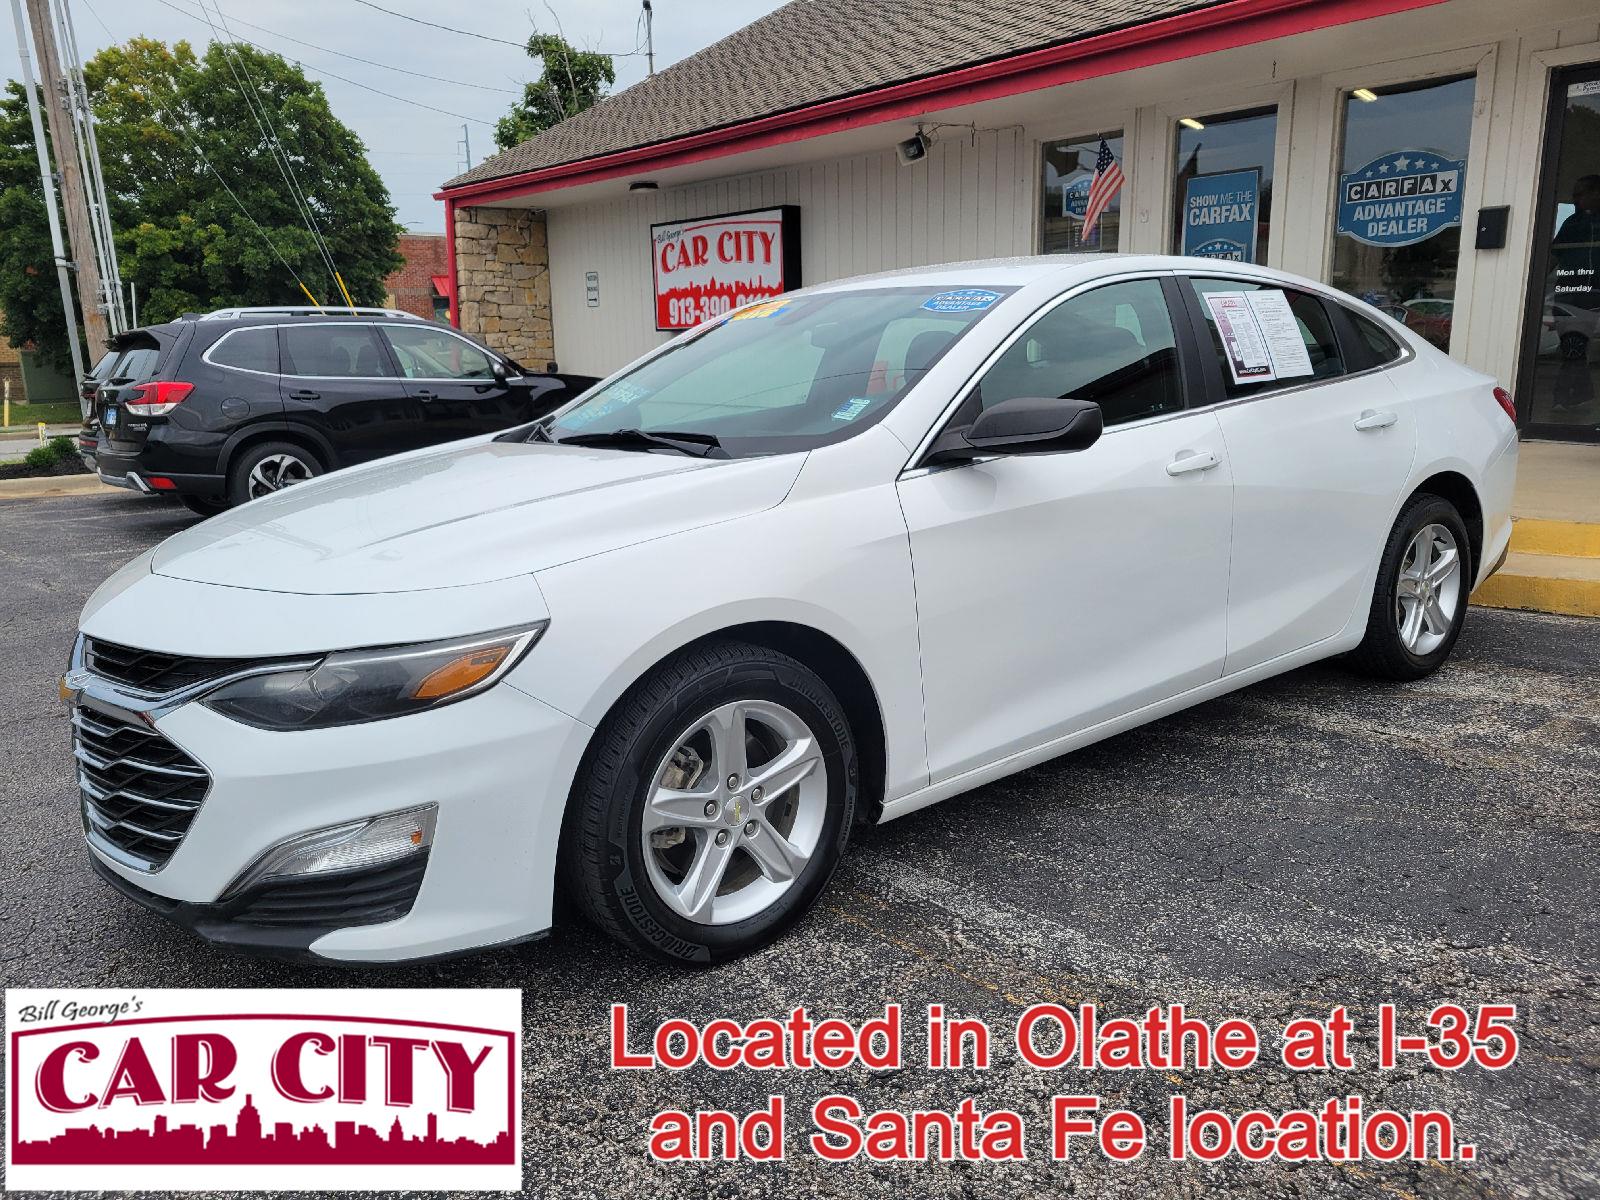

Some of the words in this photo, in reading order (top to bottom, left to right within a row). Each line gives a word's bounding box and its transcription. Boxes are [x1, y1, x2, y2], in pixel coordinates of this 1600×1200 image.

[1350, 177, 1453, 200] CARFAX
[1190, 194, 1219, 208] SHOW
[1221, 192, 1234, 204] ME
[1236, 191, 1253, 202] THE
[1353, 198, 1446, 221] ADVANTAGE
[1367, 217, 1428, 237] DEALER
[661, 235, 709, 273] CAR
[716, 230, 776, 264] CITY
[1554, 285, 1592, 293] Saturday
